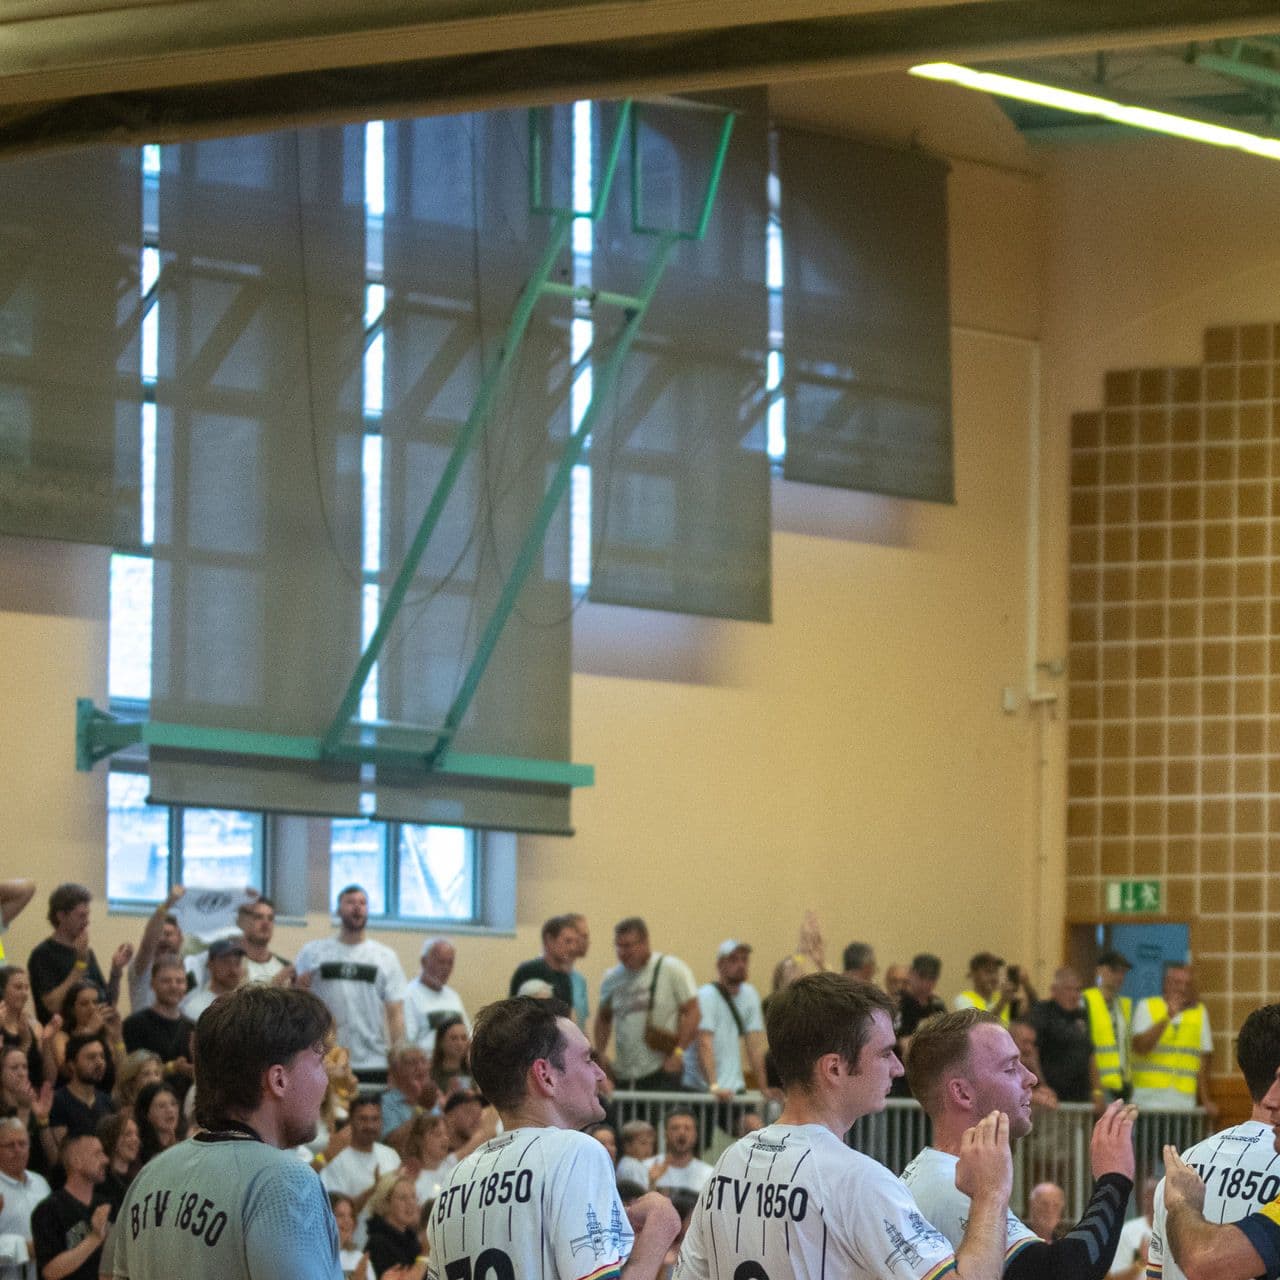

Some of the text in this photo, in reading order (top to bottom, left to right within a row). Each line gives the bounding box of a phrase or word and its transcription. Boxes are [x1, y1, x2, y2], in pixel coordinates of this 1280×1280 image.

[437, 1168, 533, 1225] BTV 1850
[705, 1175, 809, 1222] BTV 1850
[1218, 1167, 1280, 1205] 1850
[131, 1190, 228, 1247] BTV 1850
